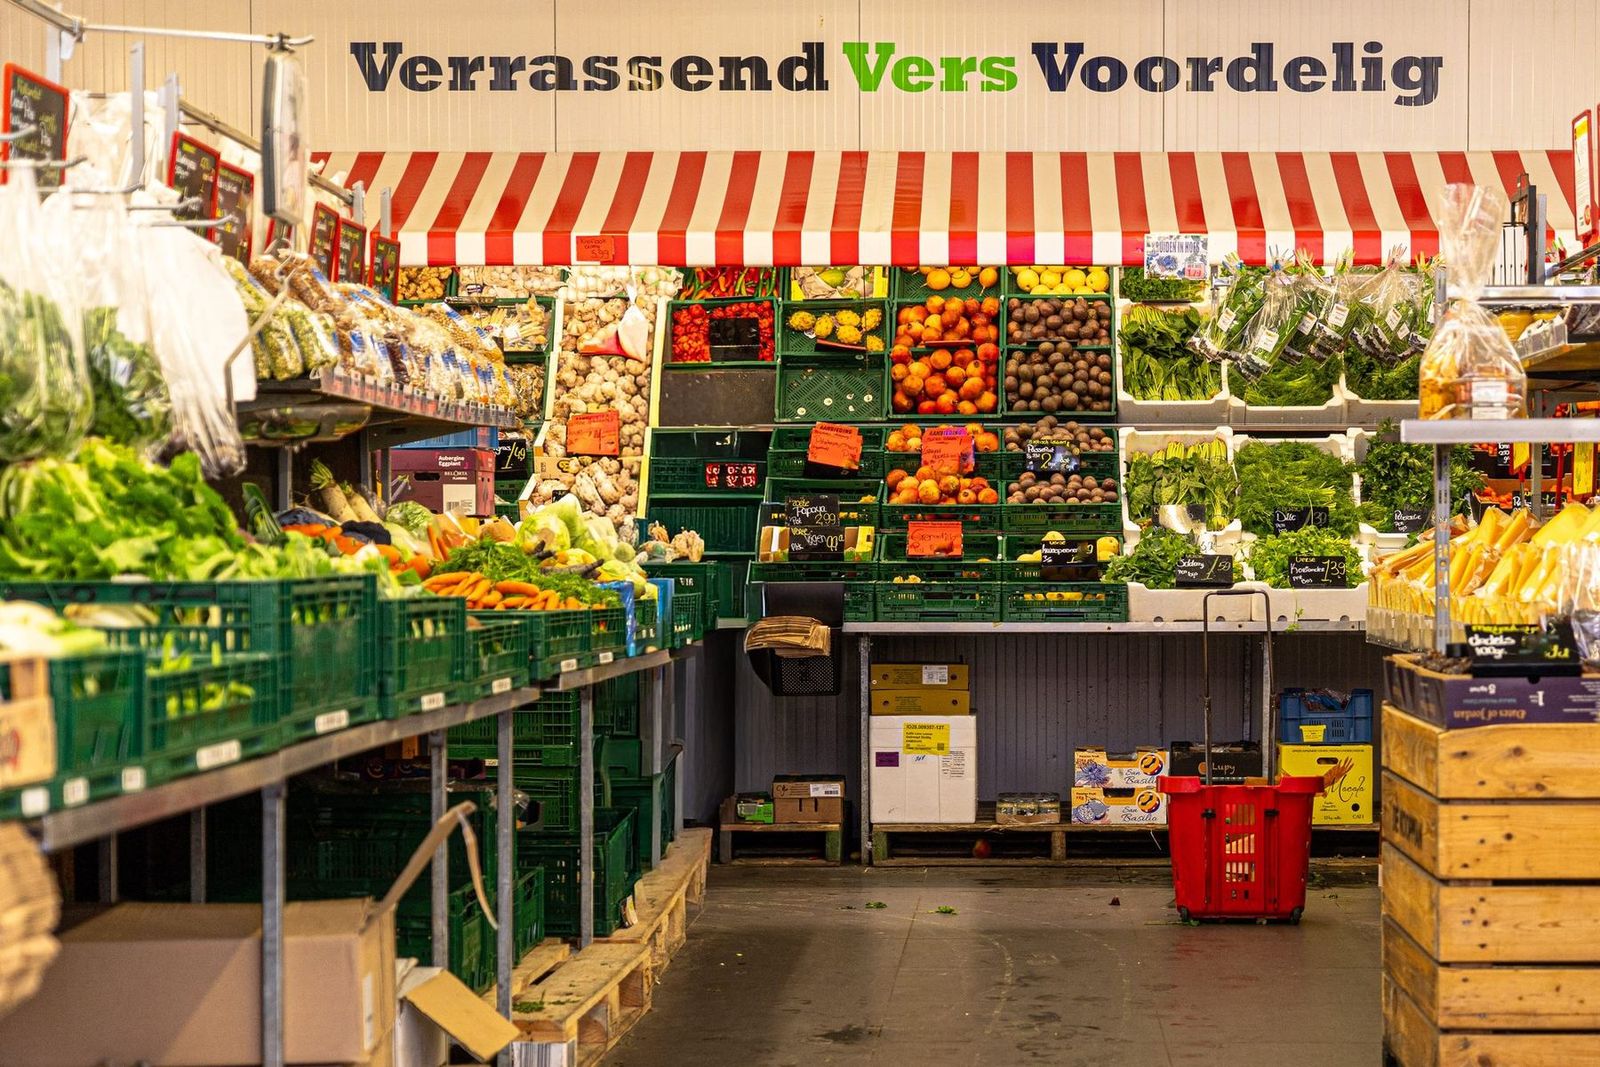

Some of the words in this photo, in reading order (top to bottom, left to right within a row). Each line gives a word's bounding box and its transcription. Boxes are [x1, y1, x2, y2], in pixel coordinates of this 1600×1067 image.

[349, 41, 829, 92] Verrassend
[842, 41, 1019, 93] Vers
[1031, 40, 1444, 107] Voordelig
[1453, 708, 1487, 721] Jordan
[1499, 709, 1527, 720] Dates
[1212, 762, 1236, 775] Lupy
[1123, 775, 1158, 785] Basili
[1120, 812, 1157, 823] Basilio
